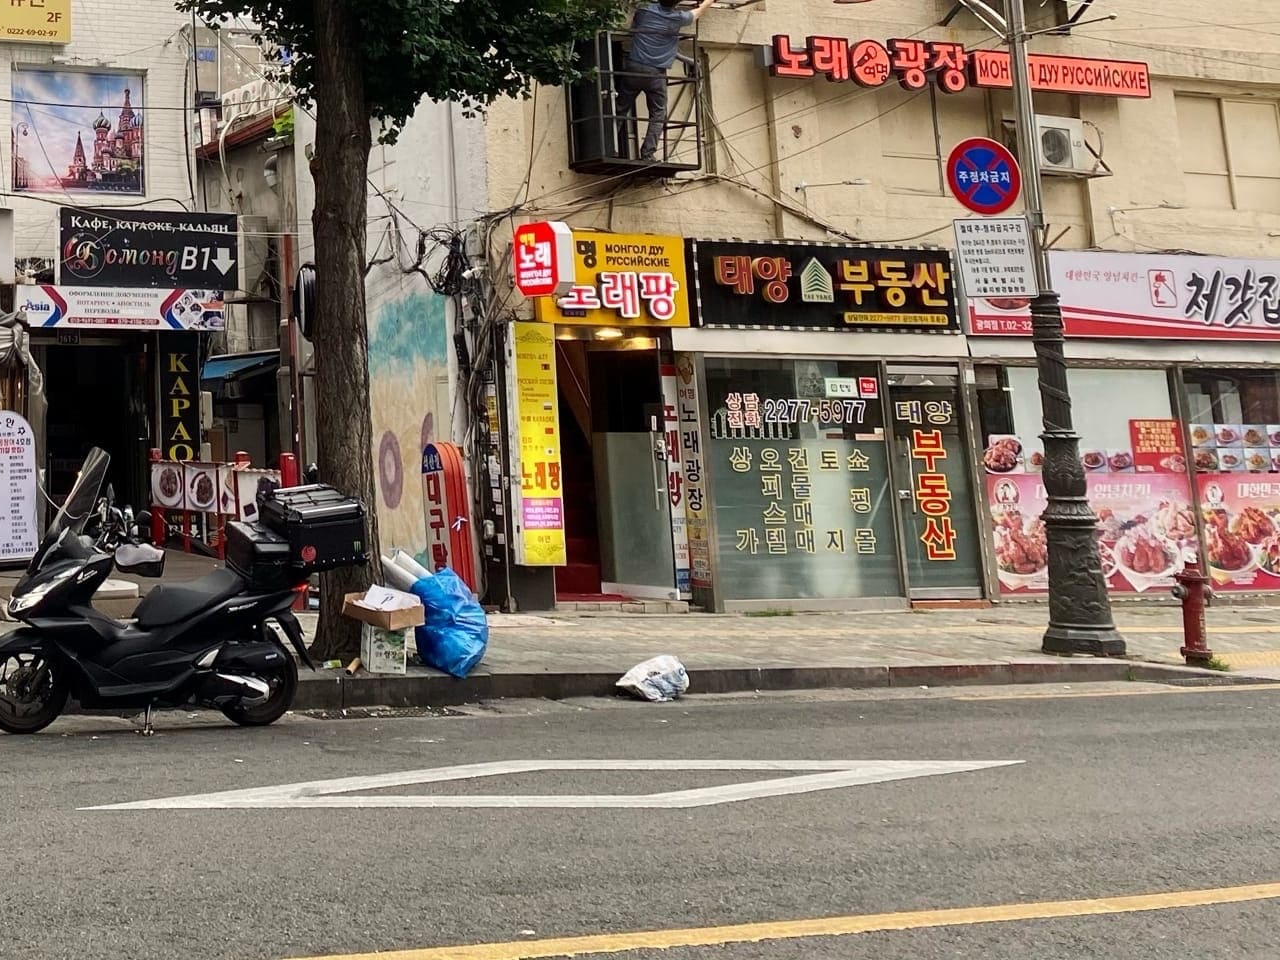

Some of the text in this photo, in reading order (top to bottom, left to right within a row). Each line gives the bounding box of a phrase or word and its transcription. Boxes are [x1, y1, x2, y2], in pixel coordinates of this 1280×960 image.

[47, 12, 63, 23] 2F
[774, 35, 967, 94] 노래 광장
[864, 63, 888, 82] 여명
[1062, 61, 1148, 91] РУССИЙСКИЕ
[958, 170, 1011, 183] 주정차금지
[180, 246, 210, 271] B1
[519, 241, 552, 270] 노래
[605, 244, 665, 256] МОНГОЛ ДУУ
[605, 256, 670, 267] РУССИЙСКИЕ
[717, 255, 950, 308] 태양 부동산
[1065, 270, 1100, 281] 대한민국
[24, 299, 50, 312] Asia
[557, 272, 679, 320] 노래팡
[726, 393, 759, 412] 상담
[764, 399, 866, 423] 2277-5977
[895, 401, 952, 423] 태양
[727, 410, 760, 428] 전화
[682, 403, 703, 511] 노래광장
[521, 461, 561, 490] 노래팡
[912, 429, 957, 561] 부동산
